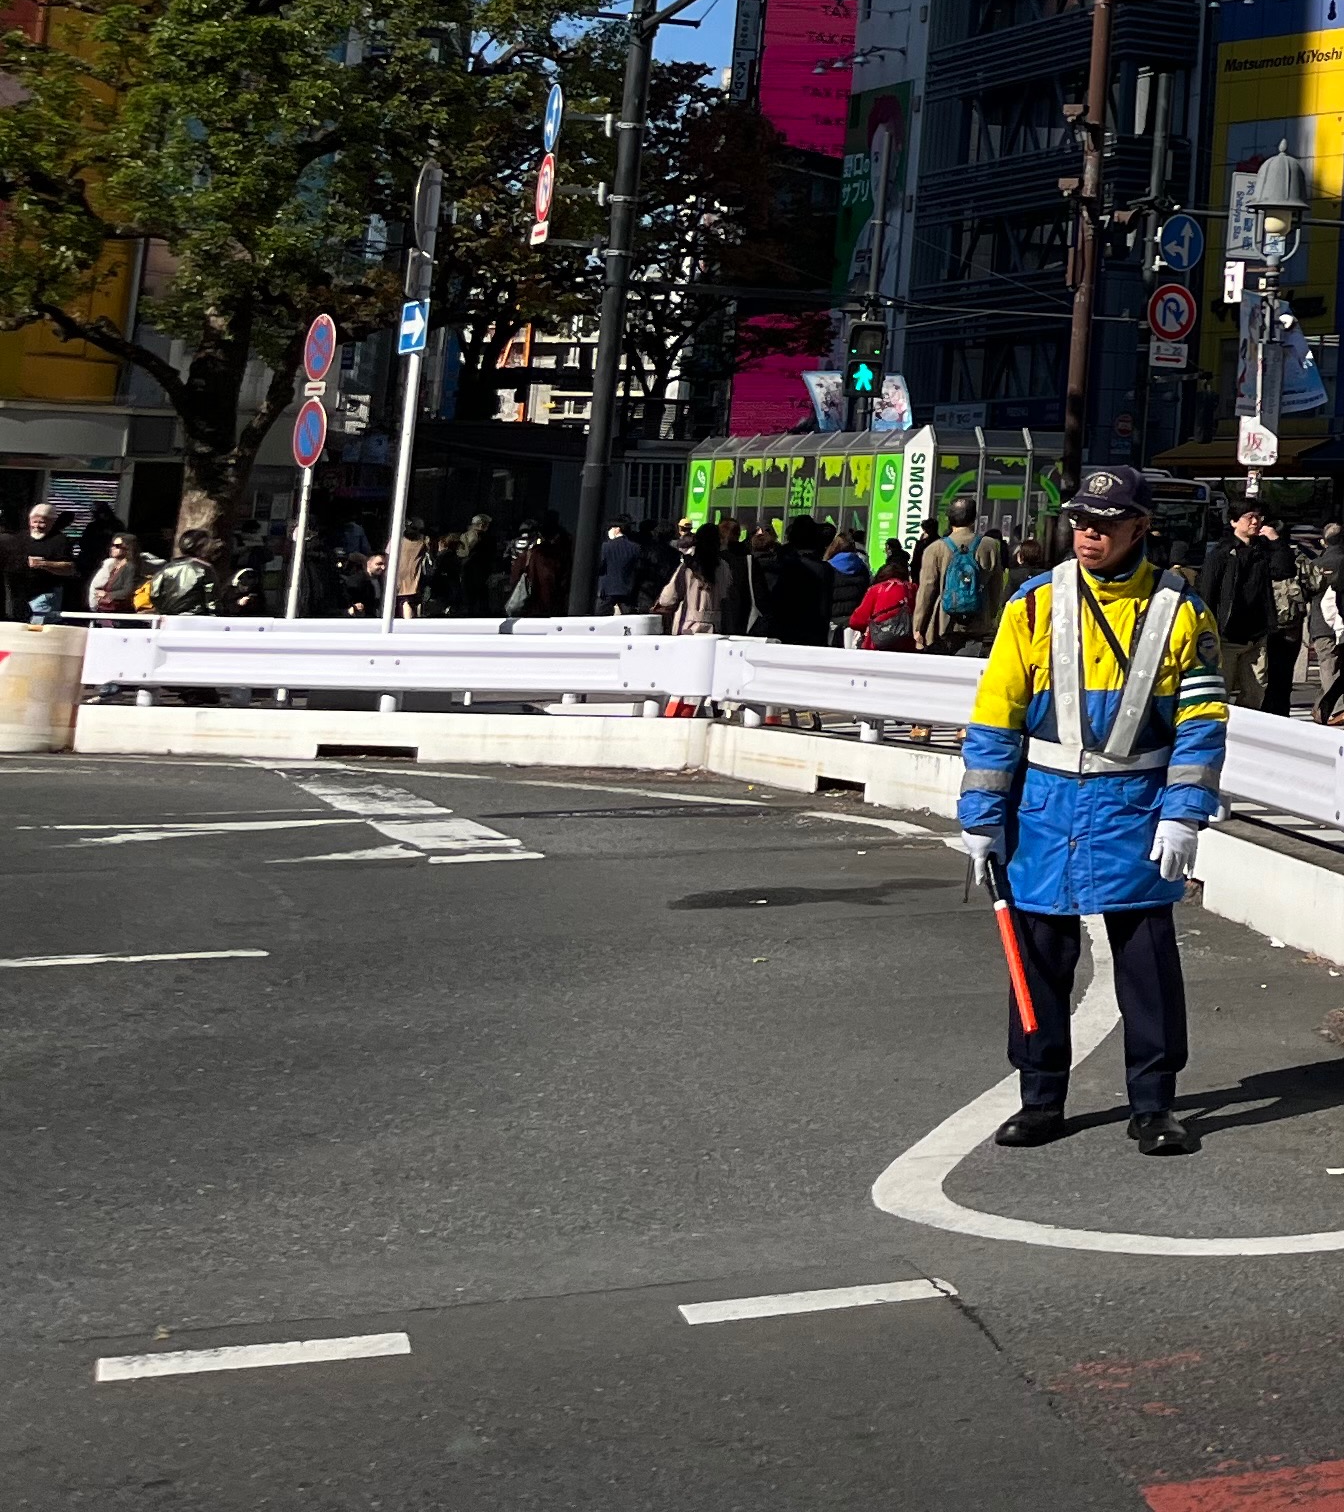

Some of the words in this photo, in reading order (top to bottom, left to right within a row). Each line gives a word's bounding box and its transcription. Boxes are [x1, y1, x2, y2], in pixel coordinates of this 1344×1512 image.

[1224, 53, 1294, 74] Matsumoto
[1295, 45, 1344, 66] KiYoshi
[903, 452, 926, 562] SMOKING
